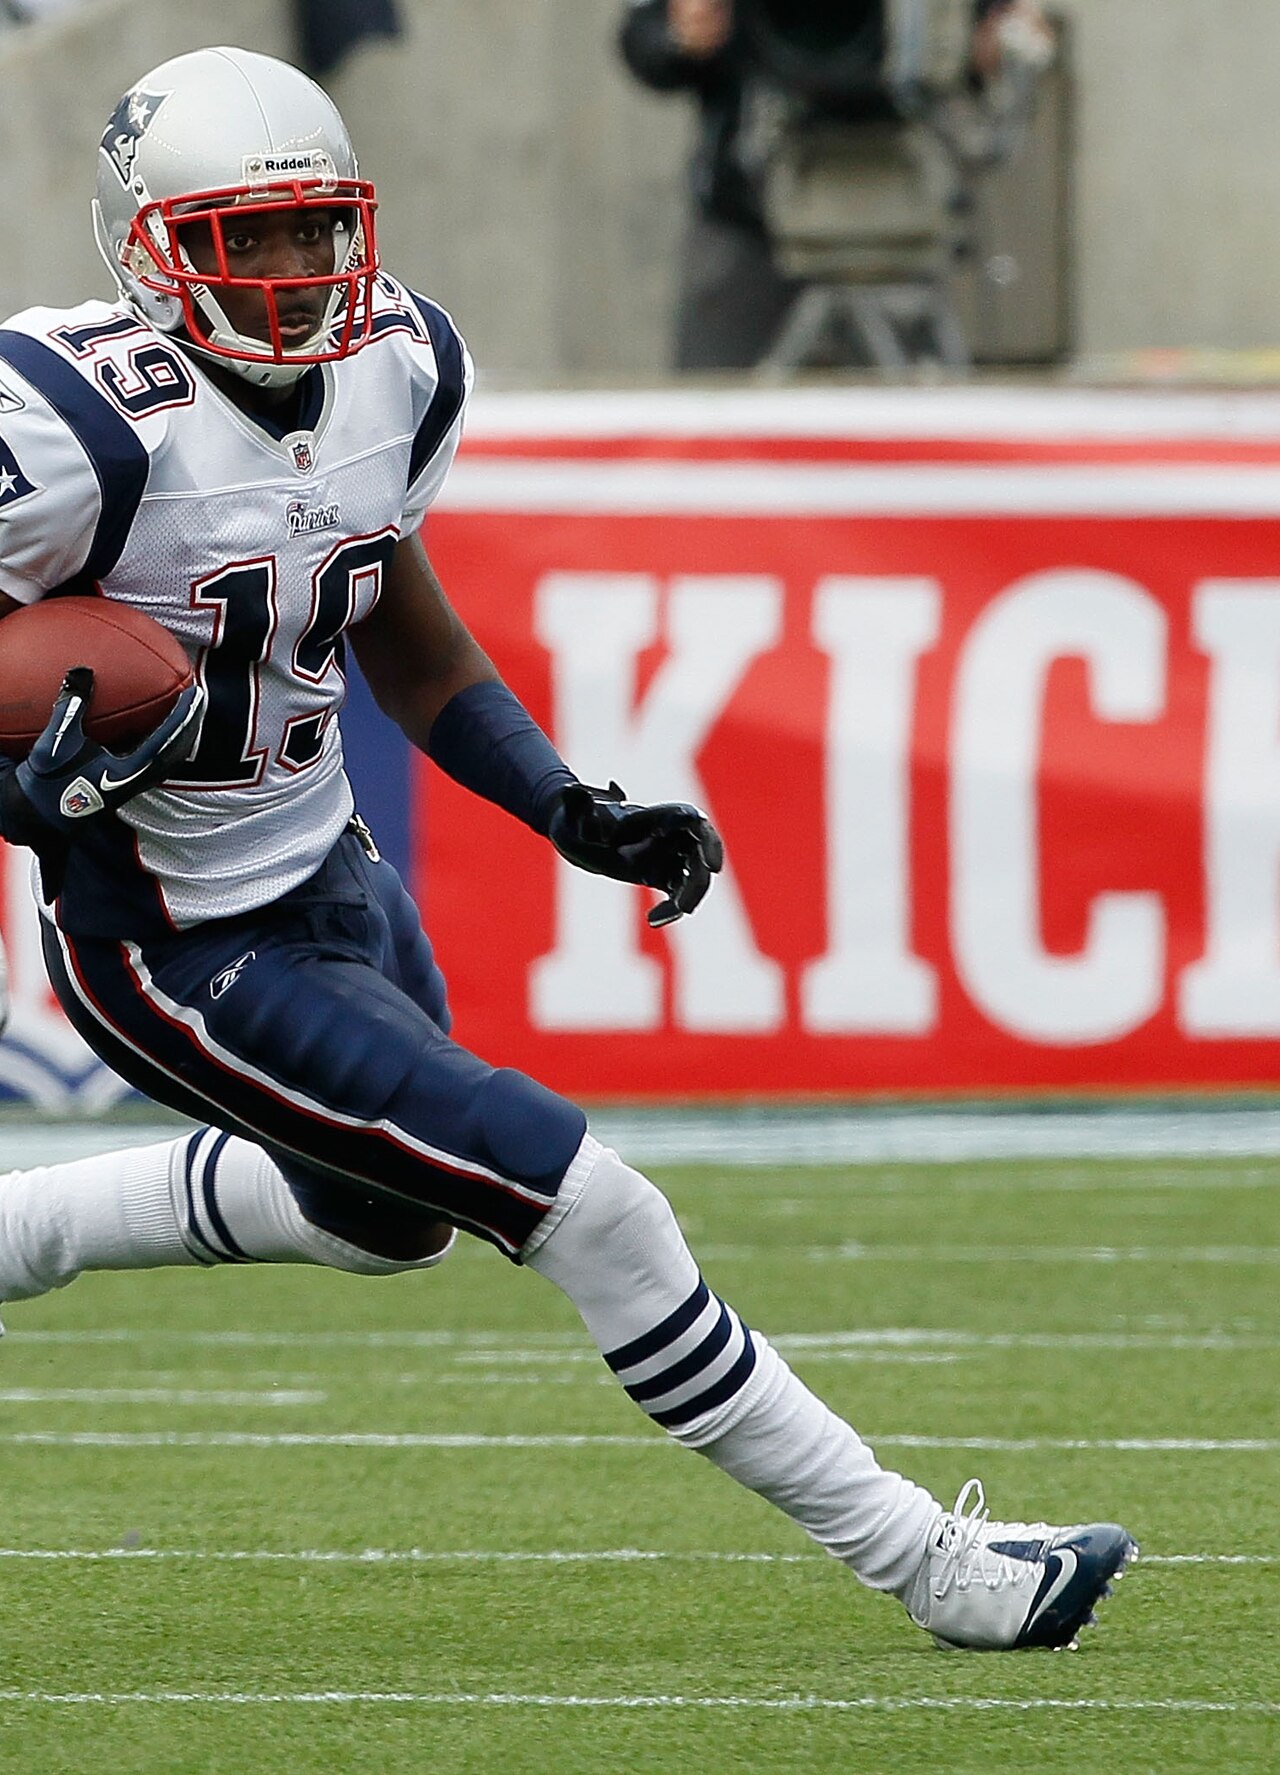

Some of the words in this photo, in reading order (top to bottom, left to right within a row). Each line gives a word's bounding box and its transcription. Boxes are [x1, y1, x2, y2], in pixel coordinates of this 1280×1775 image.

[265, 157, 312, 171] Riddell
[47, 312, 197, 421] 19
[158, 524, 398, 792] 19
